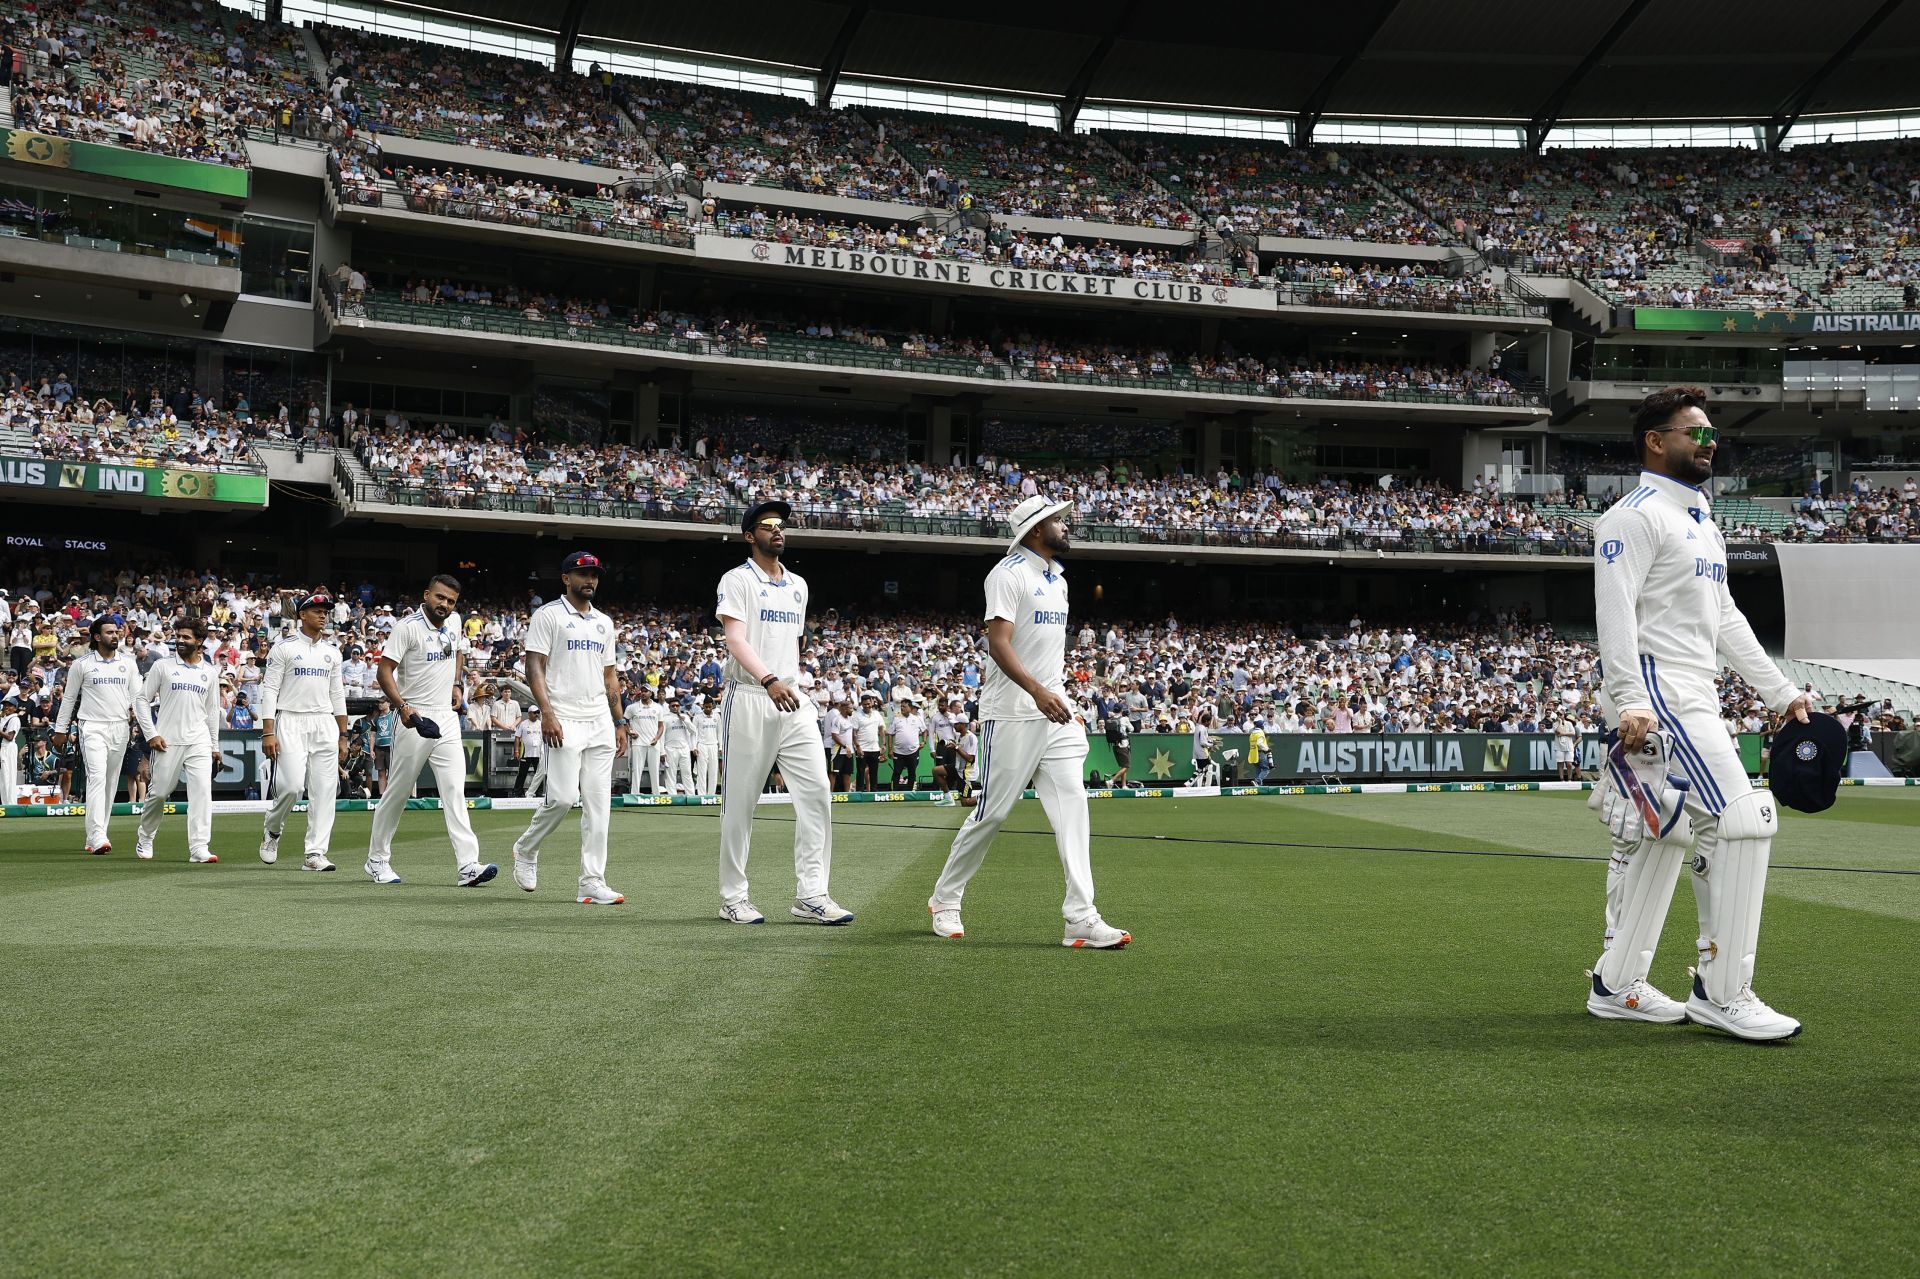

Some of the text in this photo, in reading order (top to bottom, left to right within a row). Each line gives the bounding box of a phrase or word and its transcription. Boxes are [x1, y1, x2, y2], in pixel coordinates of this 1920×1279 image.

[785, 247, 971, 283] MELBOURNE
[990, 270, 1115, 295] CRICKET
[1134, 281, 1202, 302] CLUB
[1812, 314, 1920, 332] AUSTRALIA
[98, 468, 145, 492] IND
[6, 536, 107, 550] ROYAL STACKS
[1727, 550, 1768, 560] mmBank
[1296, 740, 1464, 773] AUSTRALIA
[1232, 788, 1258, 796] bet365
[1326, 786, 1352, 794] bet365
[1505, 783, 1529, 791] bet365
[1135, 790, 1162, 798] bet365
[638, 797, 672, 805] bet365
[701, 797, 722, 805] bet3
[46, 806, 85, 816] bet36
